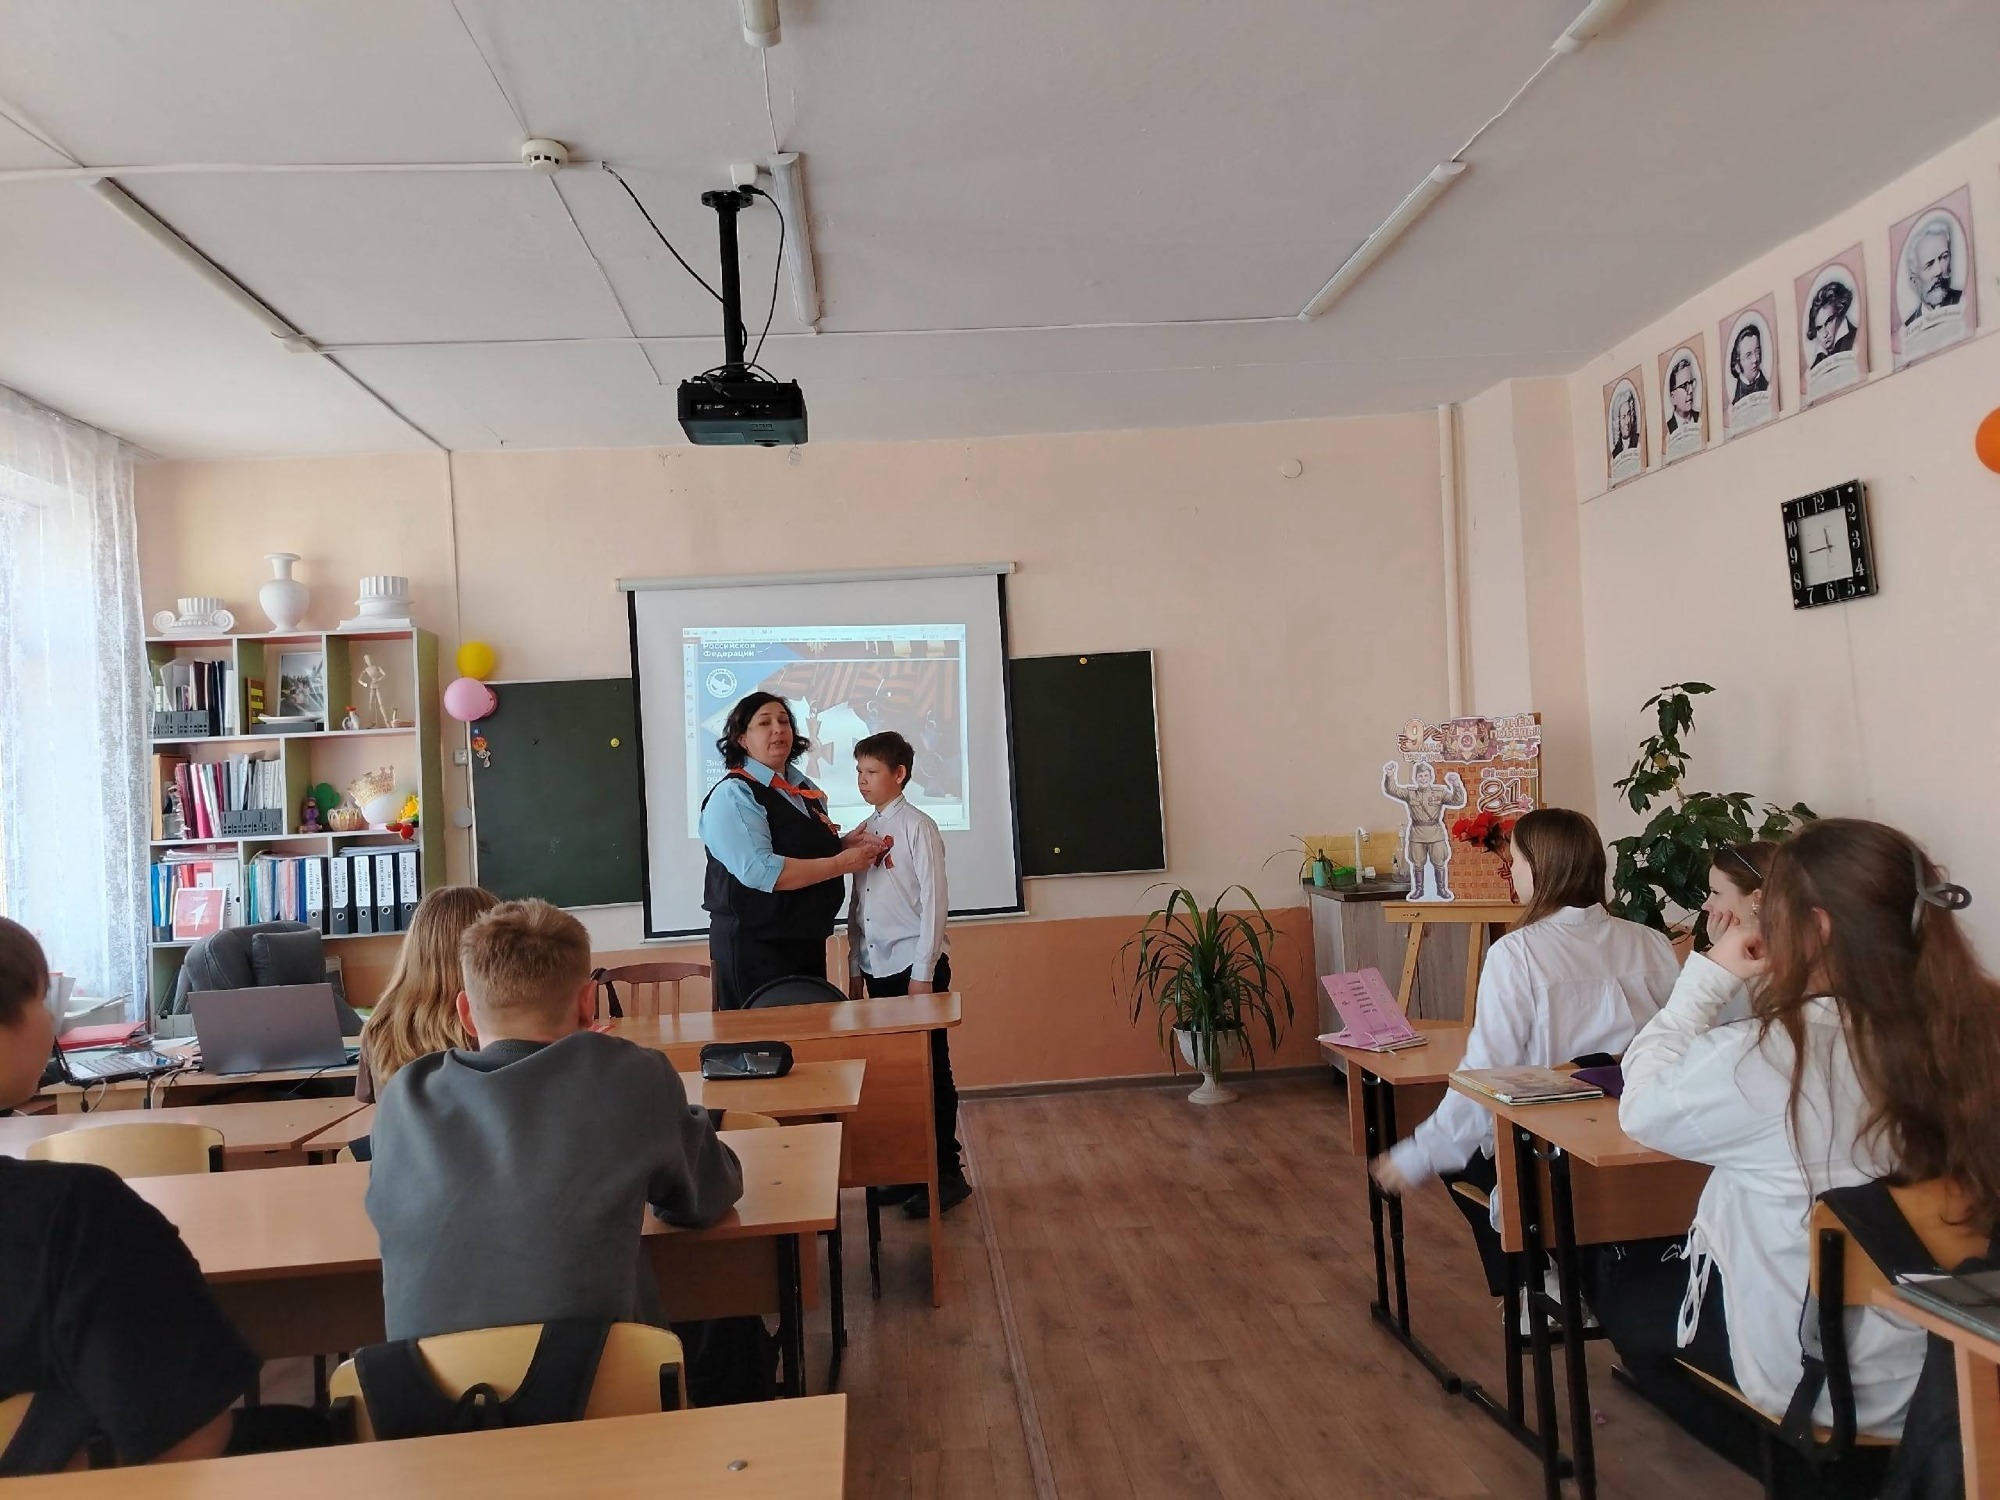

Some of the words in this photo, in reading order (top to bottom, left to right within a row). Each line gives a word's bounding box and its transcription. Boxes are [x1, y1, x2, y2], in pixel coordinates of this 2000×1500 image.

[1813, 494, 1825, 513] 12
[1835, 490, 1841, 507] 1
[1796, 501, 1805, 518] 11
[1847, 502, 1856, 521] 2
[1786, 520, 1798, 539] 10
[1851, 529, 1861, 548] 3
[1789, 547, 1798, 565] 9
[1855, 557, 1865, 576] 4
[1793, 572, 1802, 591] 8
[1846, 579, 1856, 596] 5
[1806, 587, 1814, 604] 7
[1826, 582, 1835, 601] 6
[703, 650, 755, 658] Федерации
[1502, 714, 1535, 729] ДНЁМ
[1404, 719, 1425, 752] 9
[1418, 743, 1444, 752] МАЯ
[1480, 779, 1521, 813] 81
